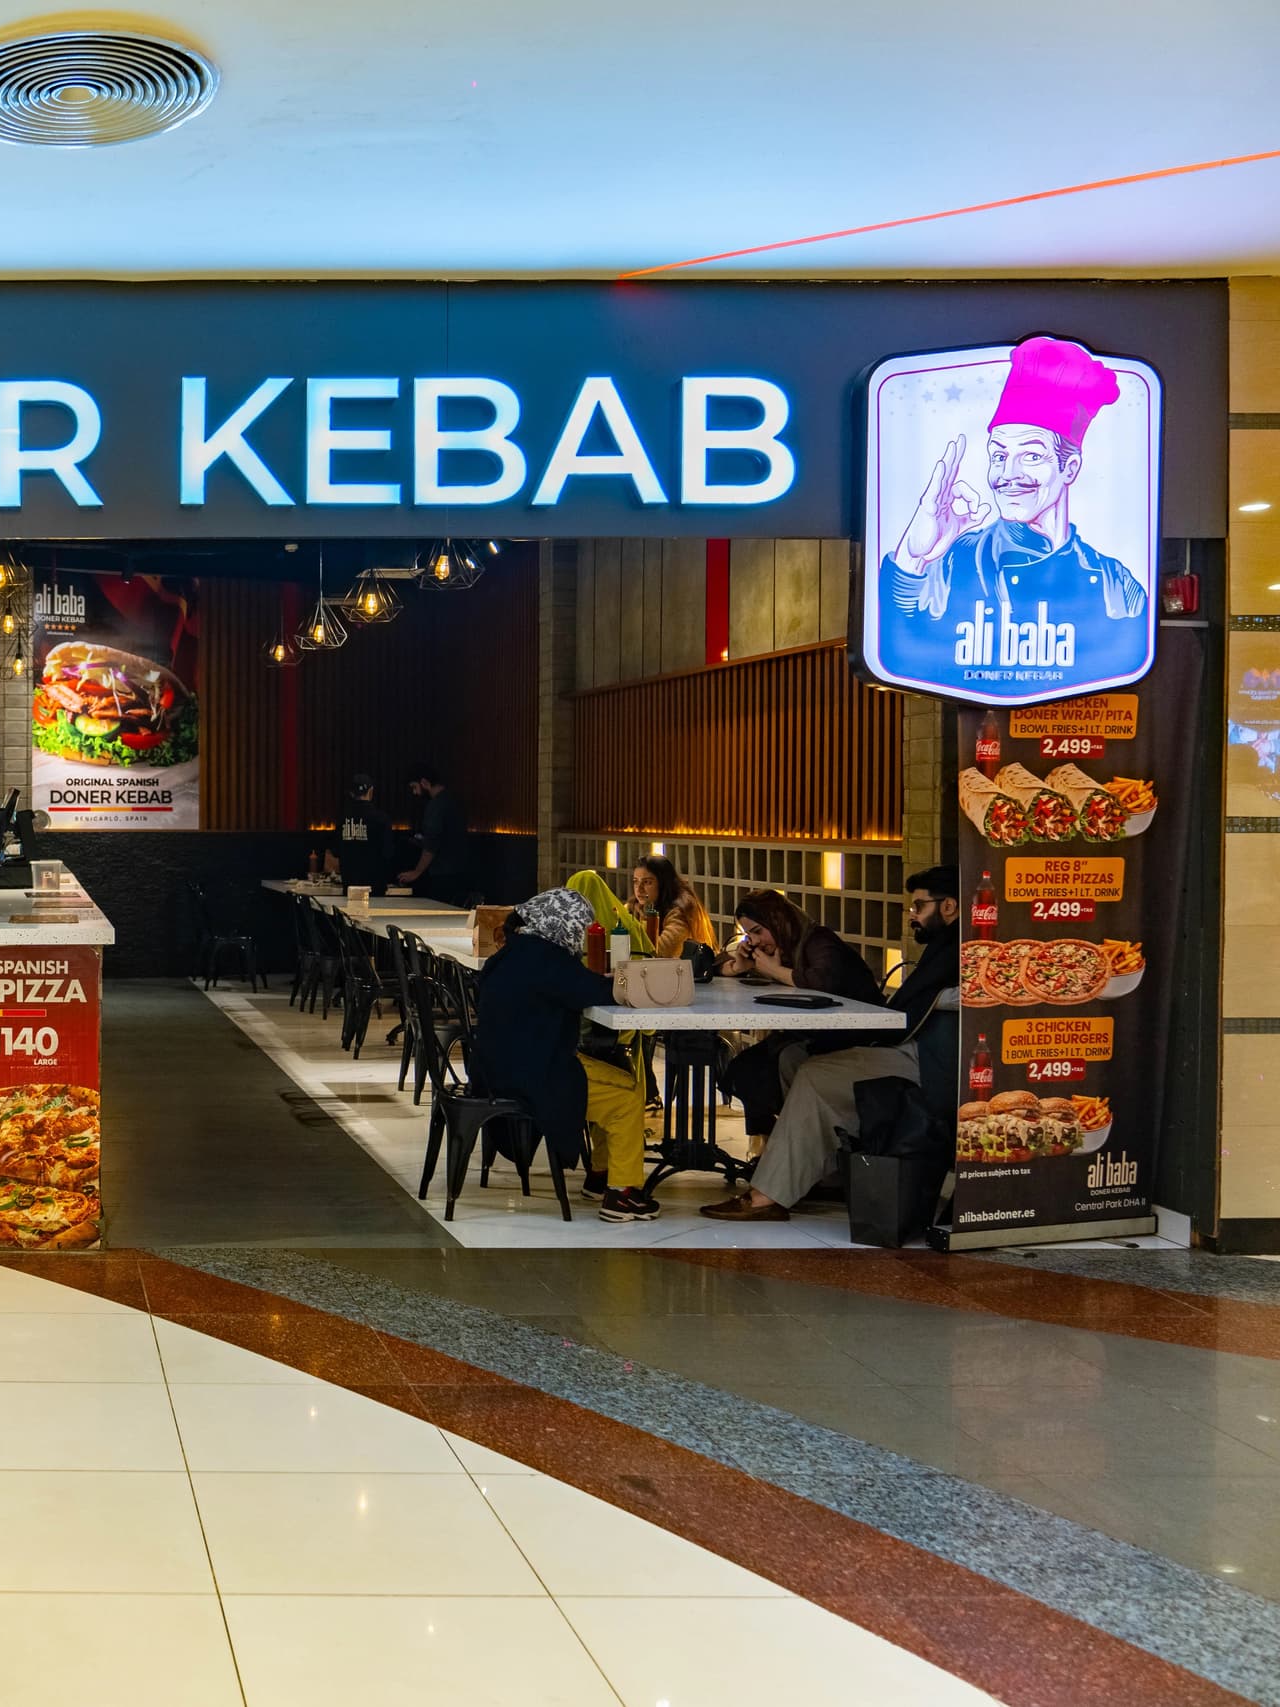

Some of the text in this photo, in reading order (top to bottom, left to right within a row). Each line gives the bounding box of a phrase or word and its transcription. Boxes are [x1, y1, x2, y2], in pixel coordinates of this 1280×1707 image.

[180, 376, 797, 506] KEBAB
[1014, 709, 1058, 720] DONER
[1106, 710, 1133, 720] PITA
[1020, 724, 1049, 733] BOWL
[1104, 725, 1133, 734] DRINK
[1042, 738, 1091, 757] 2,499
[65, 778, 160, 786] ORIGINAL SPANISH
[50, 790, 173, 804] DONER KEBAB
[1044, 861, 1071, 872] REG
[1015, 873, 1114, 884] 3 DONER PIZZAS
[1013, 888, 1040, 897] BOWL
[1095, 888, 1121, 897] DRINK
[1033, 902, 1081, 920] 2,499
[1026, 1021, 1091, 1033] 3 CHICKEN
[1009, 1033, 1109, 1046] GRILLED BURGERS
[1011, 1049, 1034, 1059] BOWL
[1085, 1047, 1111, 1056] DRINK
[1029, 1061, 1072, 1080] 2,499
[959, 1171, 967, 1179] all
[968, 1170, 987, 1179] prices
[988, 1168, 1011, 1177] subject
[1074, 1201, 1104, 1211] Central
[1105, 1199, 1122, 1208] Park
[1123, 1198, 1140, 1207] DHA
[959, 1209, 1036, 1223] alibabadoner.es
